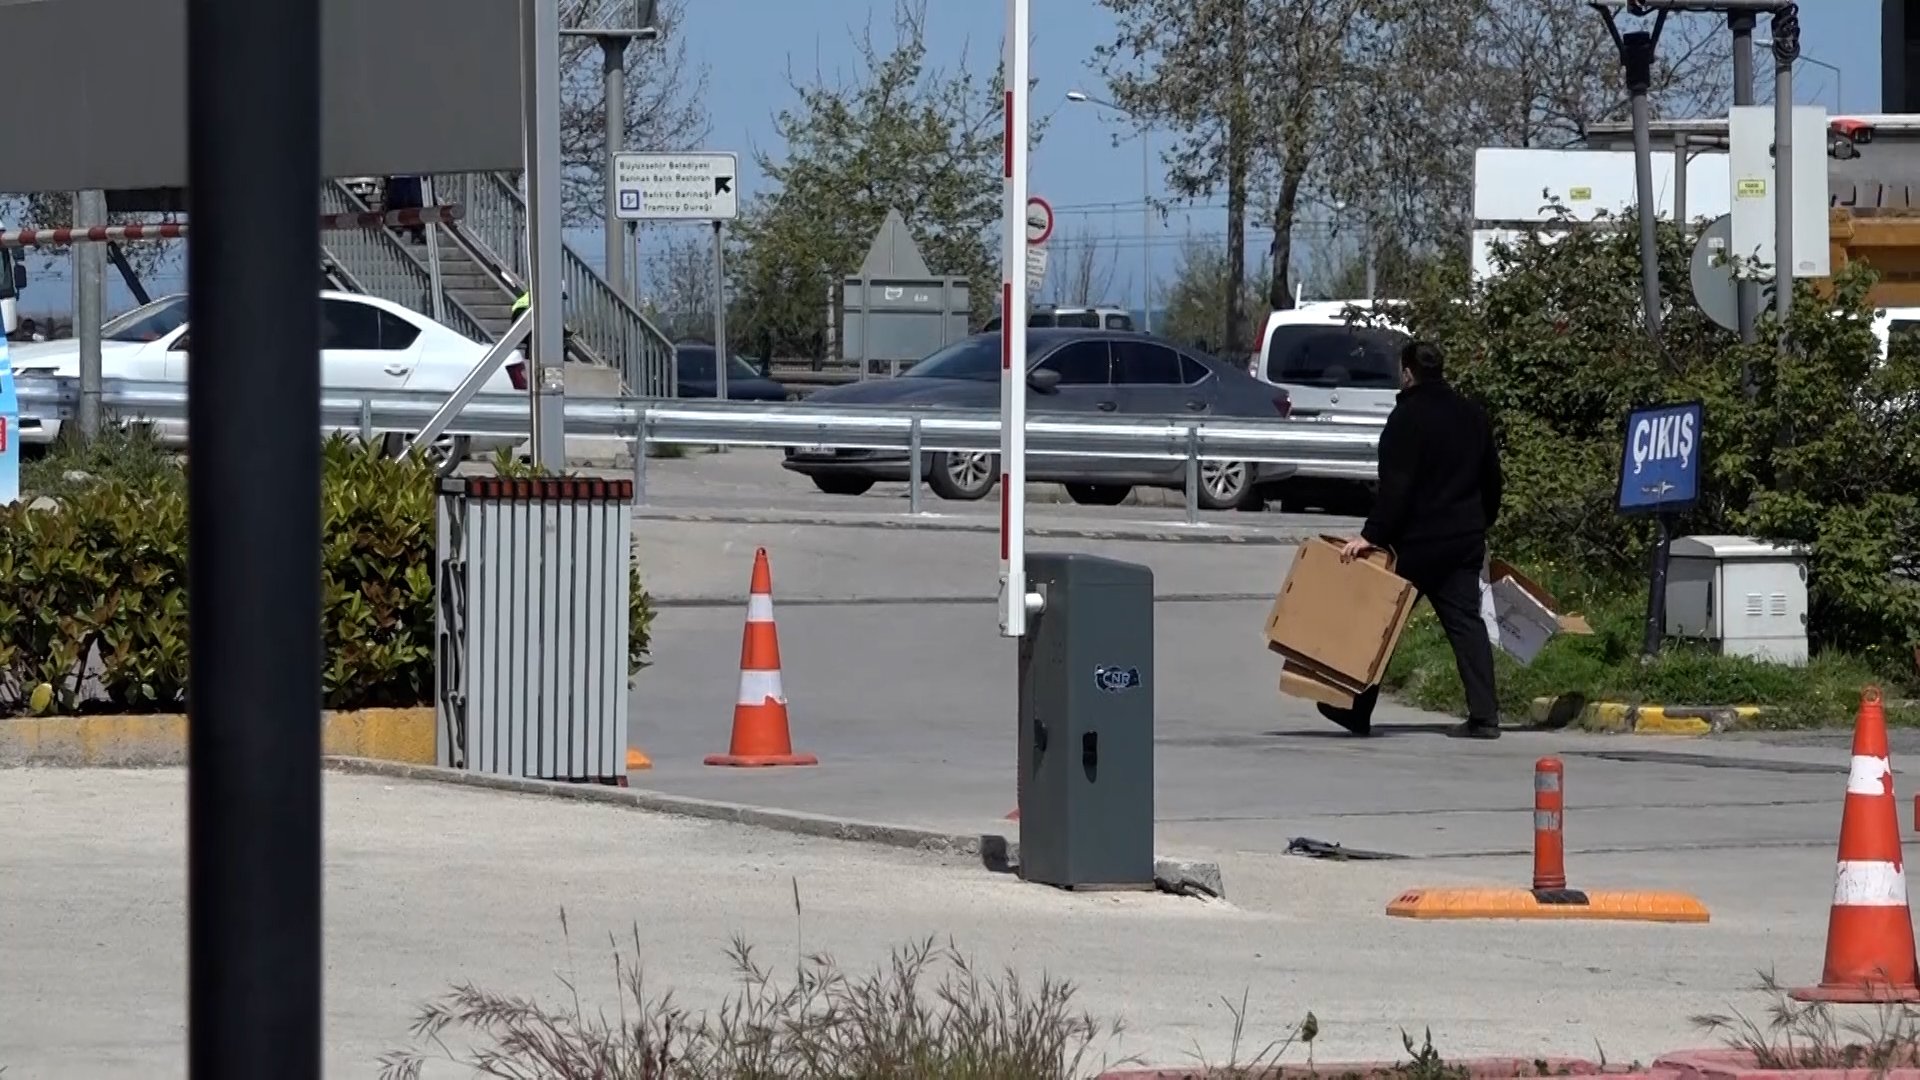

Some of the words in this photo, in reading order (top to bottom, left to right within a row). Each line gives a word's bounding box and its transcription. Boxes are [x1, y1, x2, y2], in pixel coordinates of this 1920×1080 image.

[669, 161, 710, 171] Belediyesi
[643, 191, 672, 199] Balıkçı
[675, 191, 712, 200] Barınağı
[643, 203, 681, 213] Tramvay
[683, 203, 712, 212] Durağı
[1633, 413, 1694, 475] ÇIKIŞ
